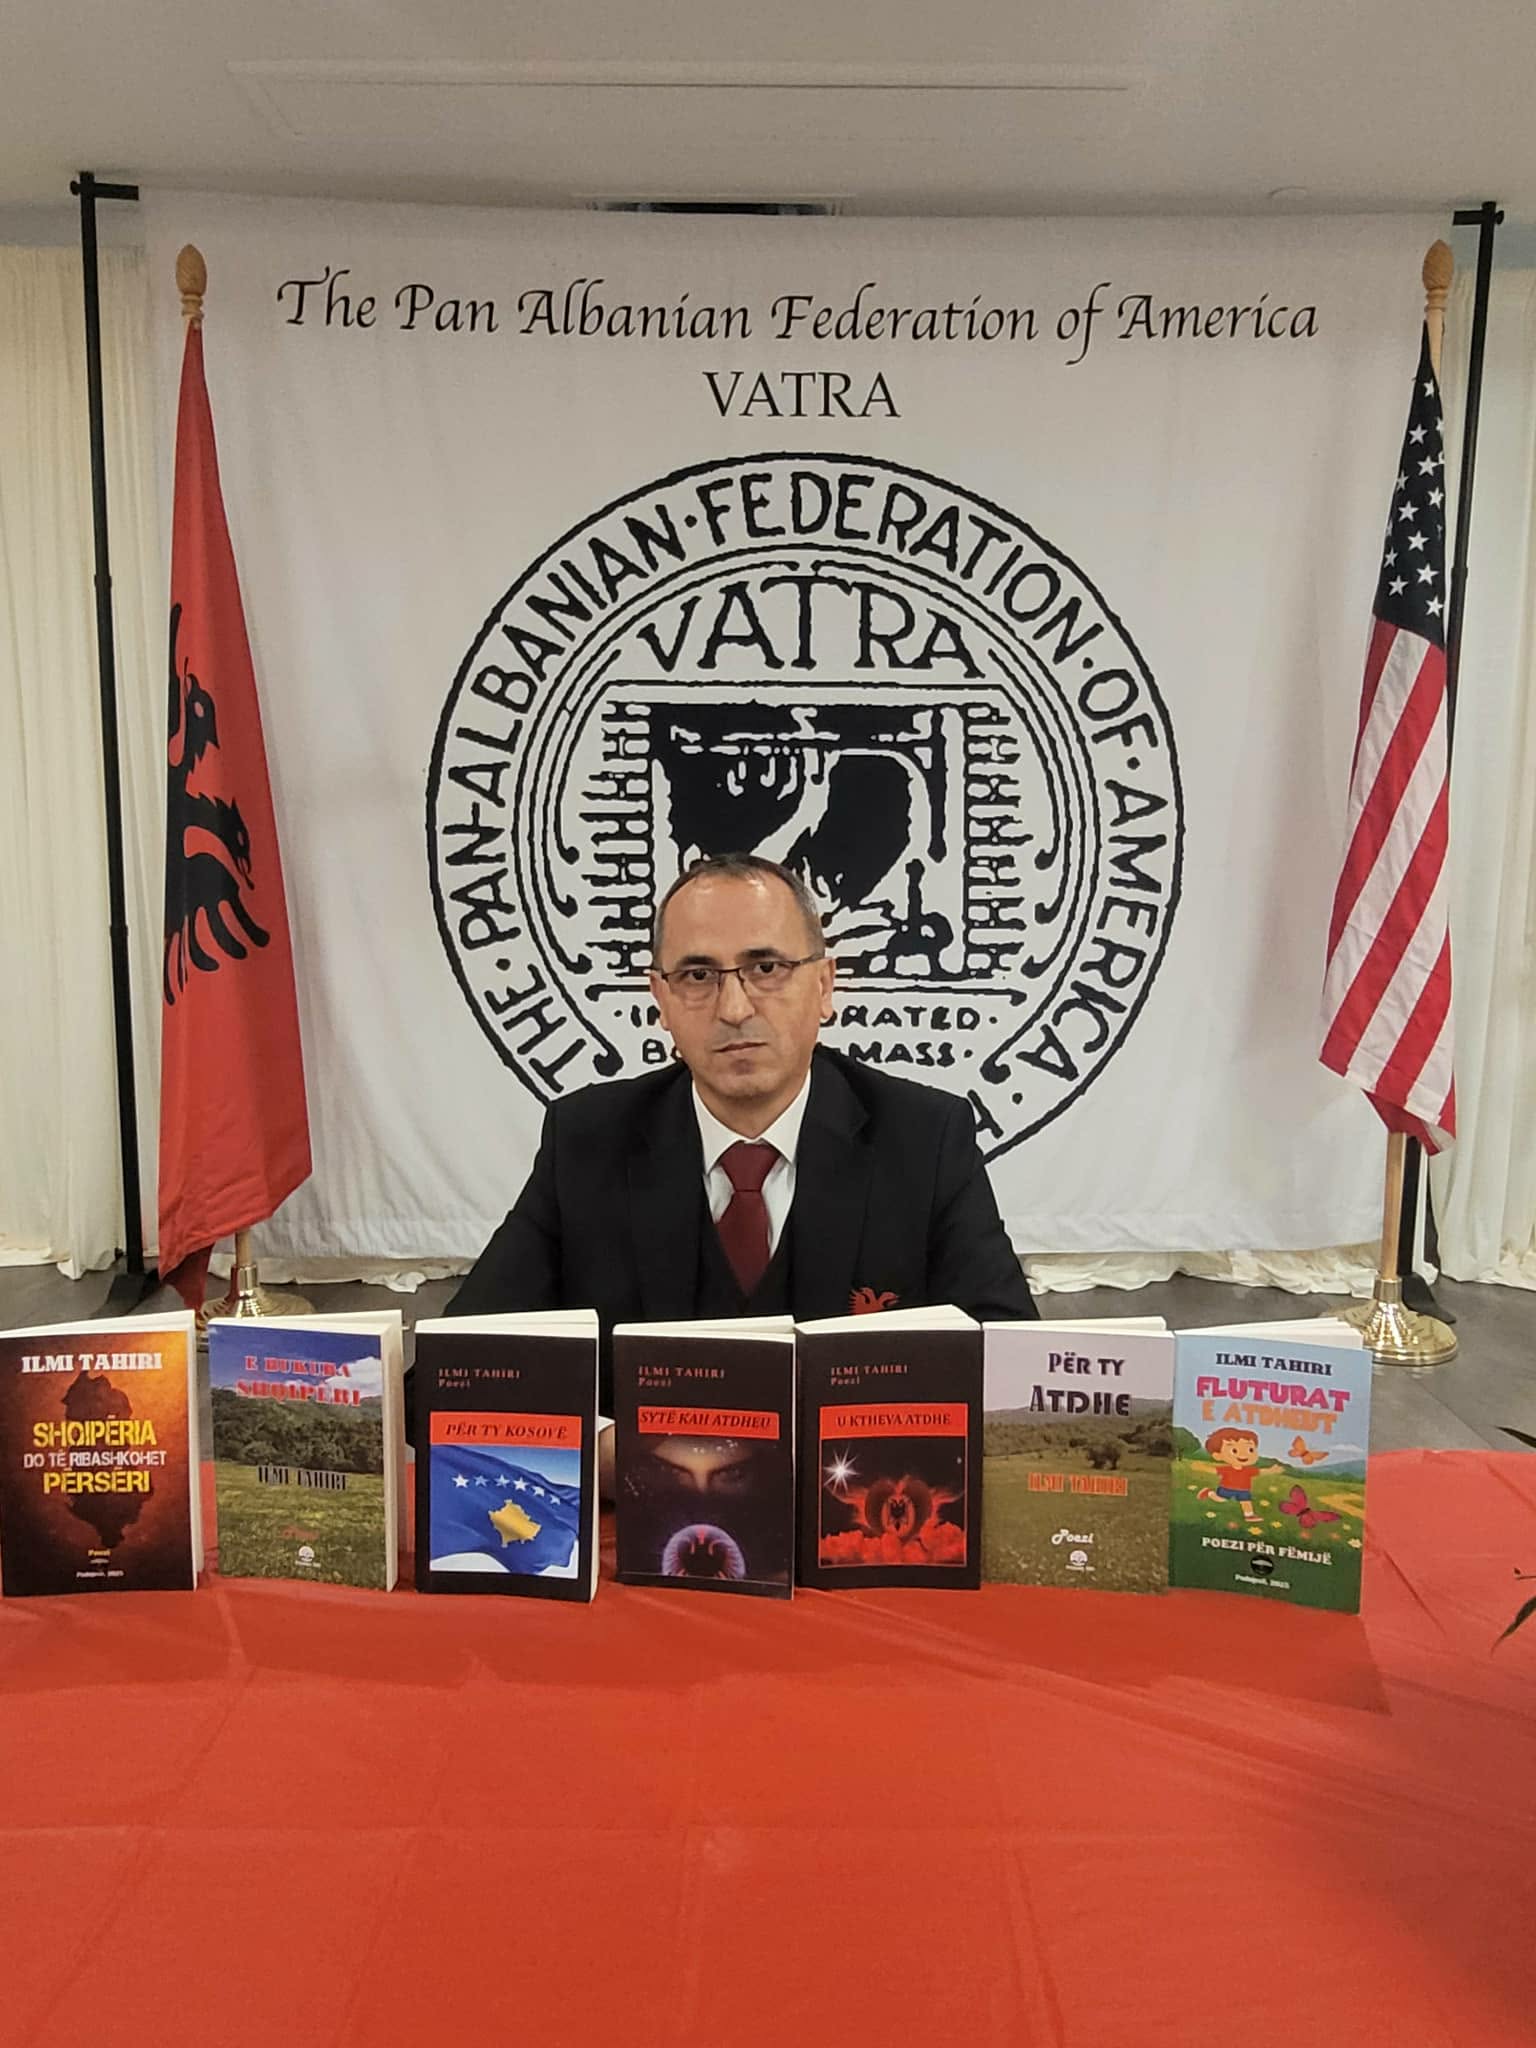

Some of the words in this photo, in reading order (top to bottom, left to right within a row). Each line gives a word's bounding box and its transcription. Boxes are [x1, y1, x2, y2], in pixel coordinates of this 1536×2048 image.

[277, 265, 377, 329] The
[394, 283, 499, 333] Pan
[516, 277, 753, 340] Albanian
[770, 281, 1039, 341] Federation
[1055, 281, 1112, 366] of
[1116, 292, 1320, 340] America
[702, 371, 901, 418] VATRA
[695, 470, 1104, 666] FEDERATION
[636, 575, 986, 679] VATRA
[1077, 668, 1159, 749] OF
[441, 503, 687, 951] PAN-ALBANIAN
[1014, 778, 1169, 1082] AMERICA
[483, 963, 588, 1094] THE
[21, 1355, 75, 1373] ILMI
[79, 1353, 163, 1371] TAHIRI
[245, 1355, 258, 1371] E
[438, 1368, 469, 1378] ILMI
[474, 1368, 521, 1379] TAHIRI
[638, 1366, 670, 1377] ILMI
[675, 1367, 725, 1379] TAHIRI
[830, 1366, 859, 1375] ILMI
[863, 1364, 908, 1375] TAHIRI
[1048, 1351, 1091, 1375] PËR
[1097, 1358, 1125, 1376] TY
[1216, 1352, 1257, 1368] ILMI
[1261, 1356, 1333, 1376] TAHIRI
[1029, 1385, 1131, 1416] ATDHE
[1196, 1375, 1351, 1413] FLUTURAT
[837, 1416, 847, 1427] U
[905, 1413, 951, 1425] ATDHE
[1201, 1399, 1216, 1422] E
[33, 1414, 157, 1448] SHQIPËRIA
[481, 1423, 501, 1436] TY
[24, 1453, 45, 1468] DO
[69, 1450, 167, 1467] RIBASHKOHET
[43, 1467, 151, 1494] PËRSËRI
[1051, 1529, 1094, 1545] Poezi
[1202, 1536, 1245, 1552] POEZI
[1247, 1541, 1275, 1556] PËR
[1278, 1546, 1333, 1566] FËMIJË
